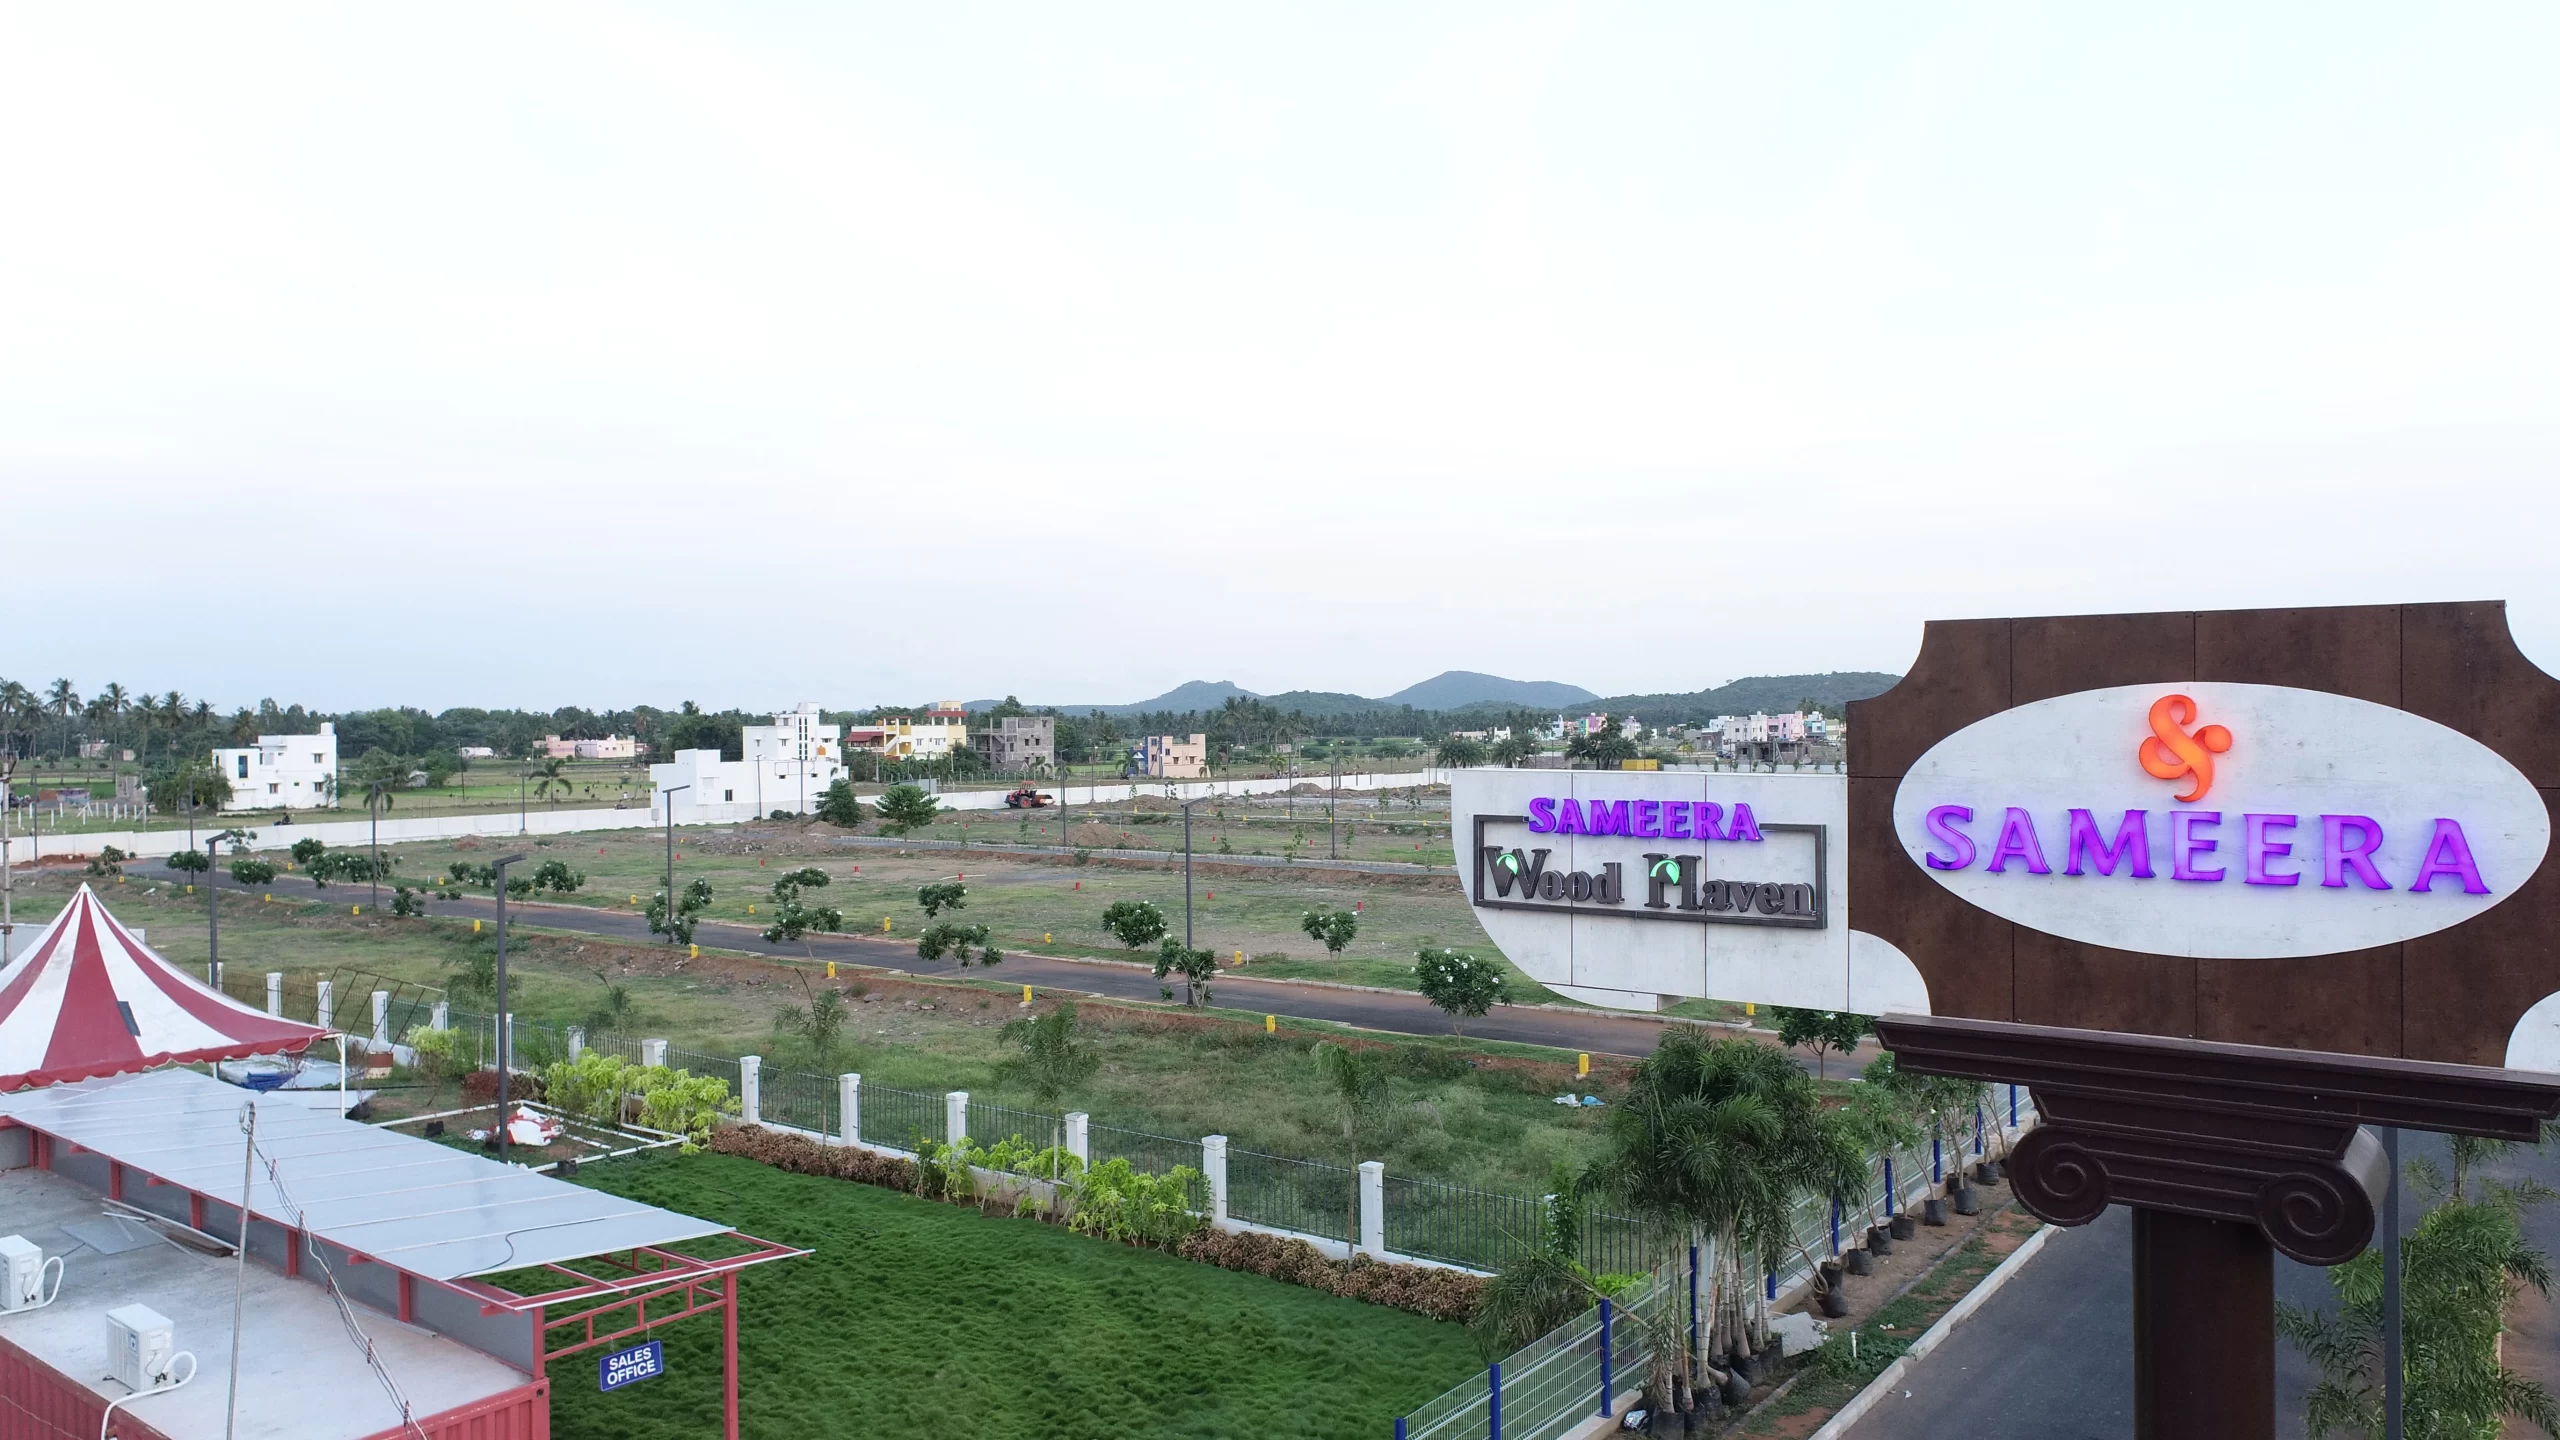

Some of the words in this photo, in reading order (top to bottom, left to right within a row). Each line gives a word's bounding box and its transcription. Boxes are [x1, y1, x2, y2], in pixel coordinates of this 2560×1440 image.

[1528, 797, 1764, 842] SAMEERA
[1925, 804, 2492, 894] SAMEERA
[1485, 845, 1625, 904] Wood
[1642, 852, 1816, 916] Haven
[607, 1360, 656, 1385] OFFICE
[609, 1347, 652, 1371] SALES
